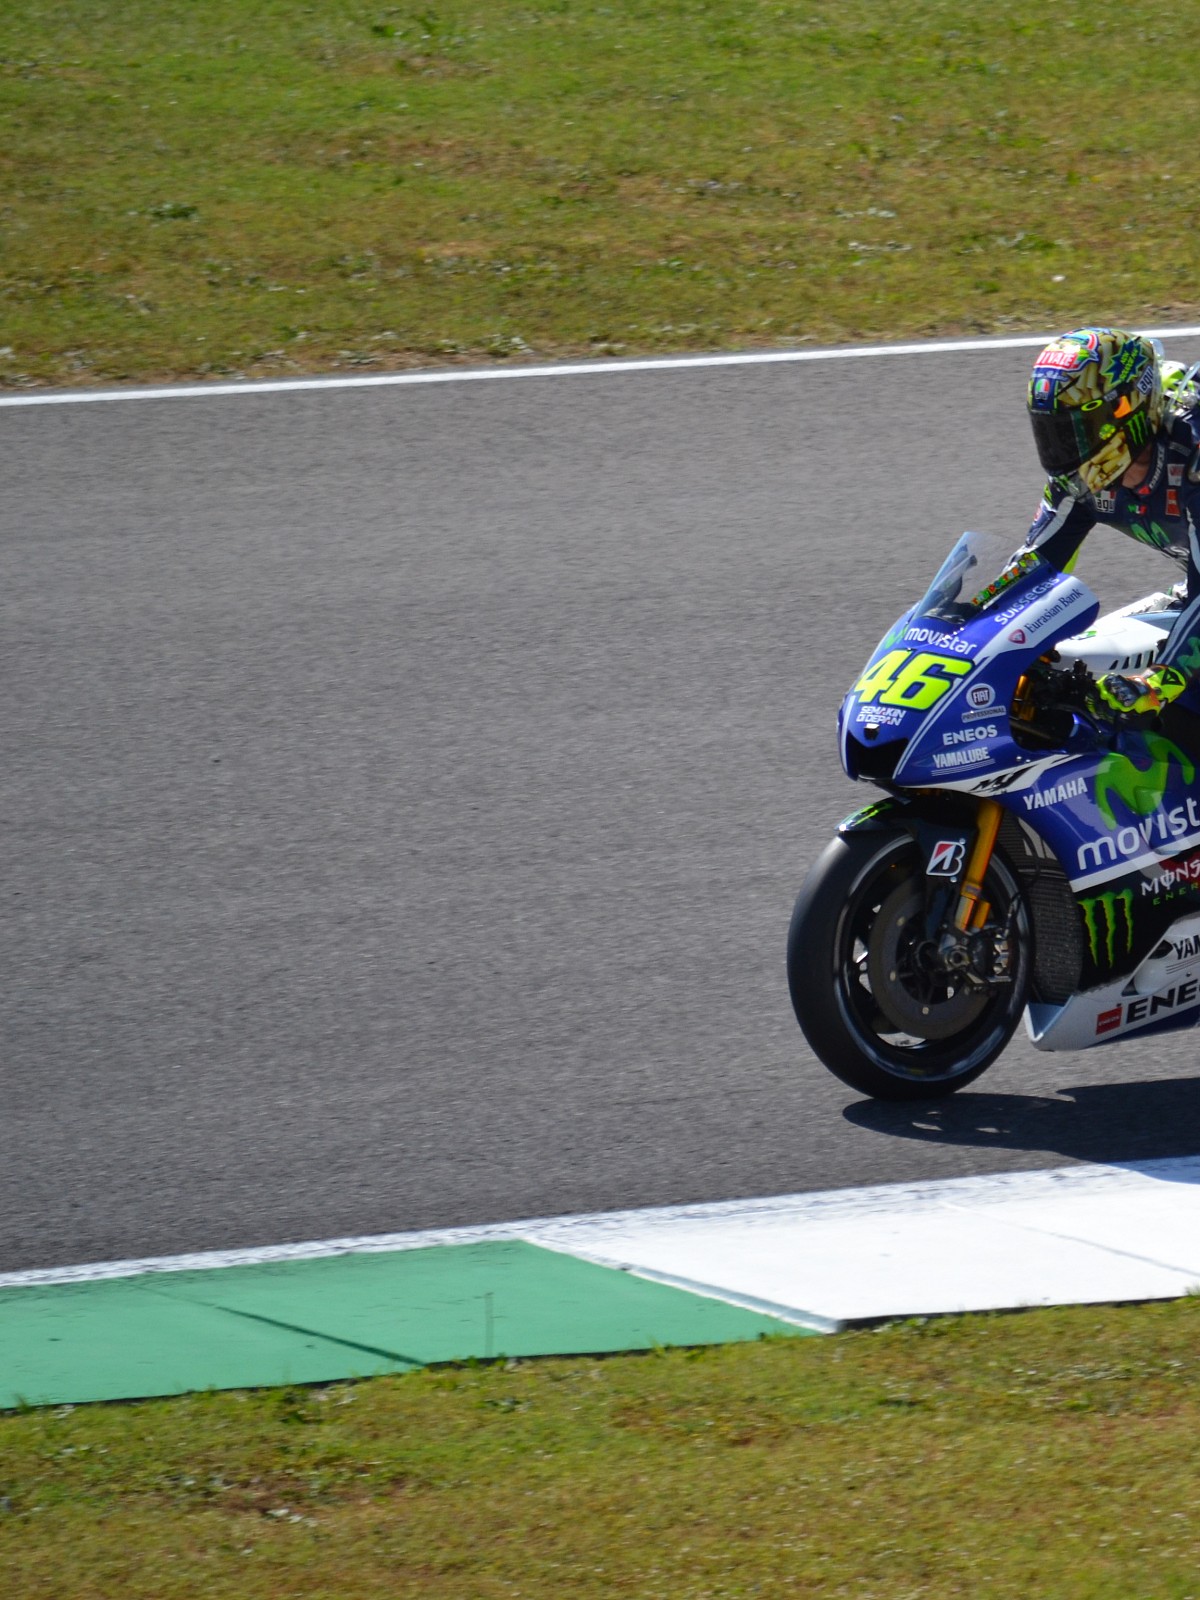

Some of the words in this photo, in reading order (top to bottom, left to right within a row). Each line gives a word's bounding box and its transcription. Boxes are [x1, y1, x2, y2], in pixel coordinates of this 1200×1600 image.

[1024, 602, 1063, 633] Eurasian
[1058, 588, 1084, 613] Bank
[904, 627, 977, 655] movistar
[854, 650, 974, 711] 46
[972, 688, 990, 704] FIAT
[860, 706, 906, 718] SEMAKIN
[865, 714, 902, 726] DEPAN
[962, 707, 1005, 720] PROFESSIONAL
[942, 725, 998, 745] ENEOS
[932, 747, 990, 768] YAMALUBE
[1023, 777, 1088, 810] YAMAHA
